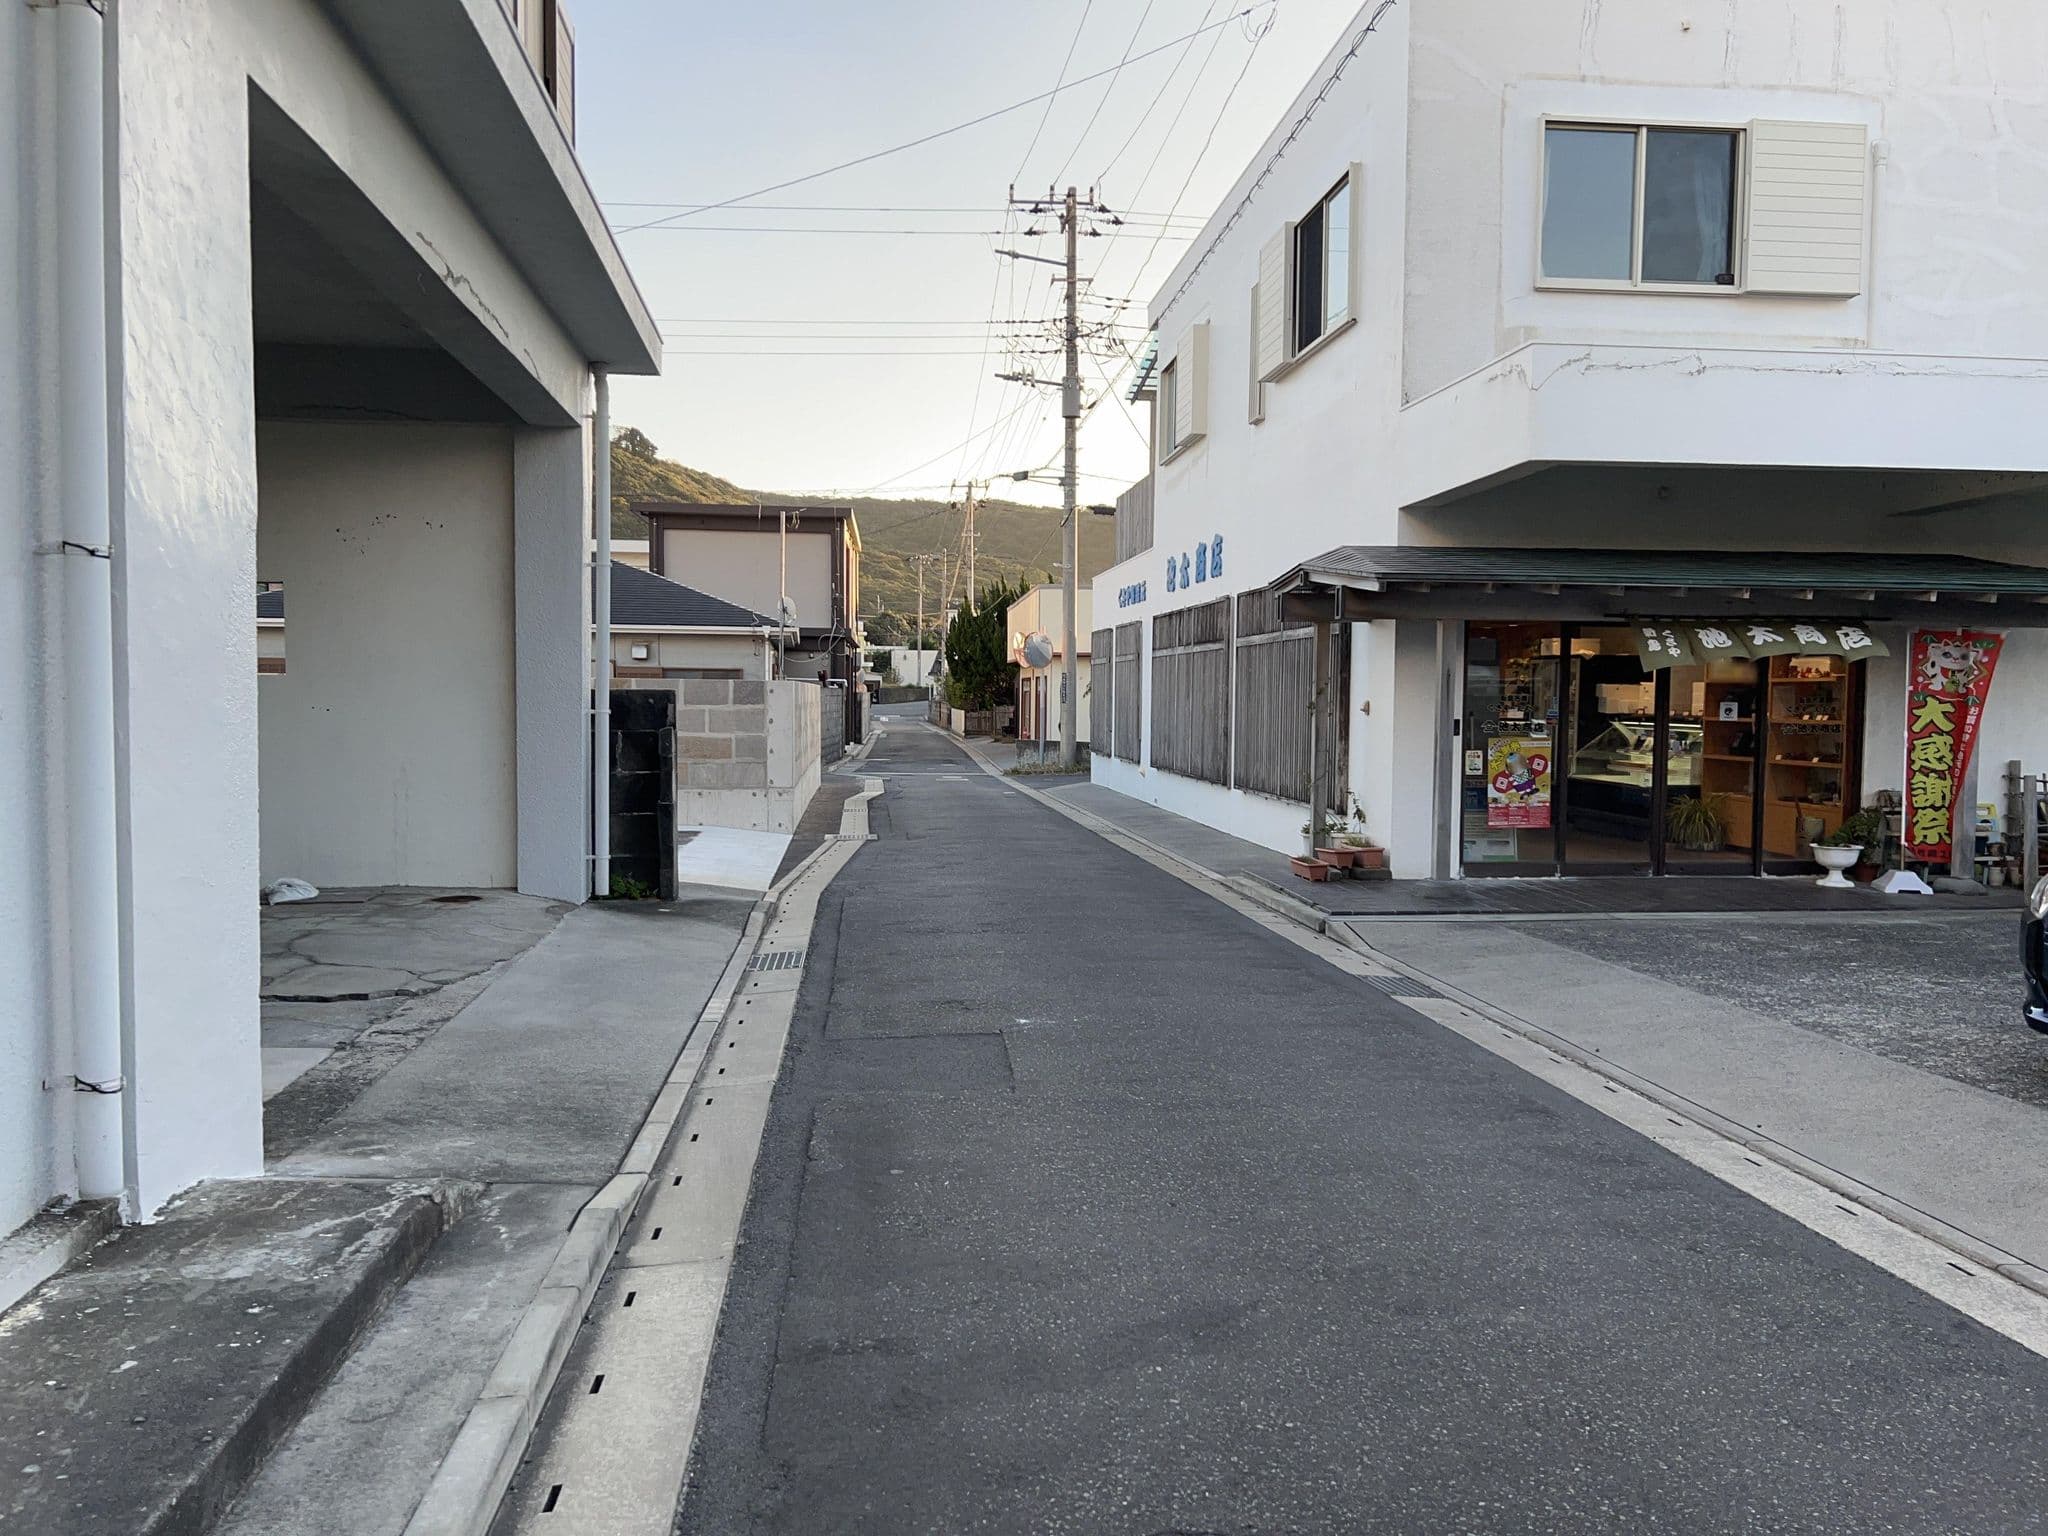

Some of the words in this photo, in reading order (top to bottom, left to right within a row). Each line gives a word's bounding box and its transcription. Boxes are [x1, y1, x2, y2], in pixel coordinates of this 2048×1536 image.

[1695, 624, 1873, 651] 池太商店
[1911, 696, 1957, 846] 大感謝祭
